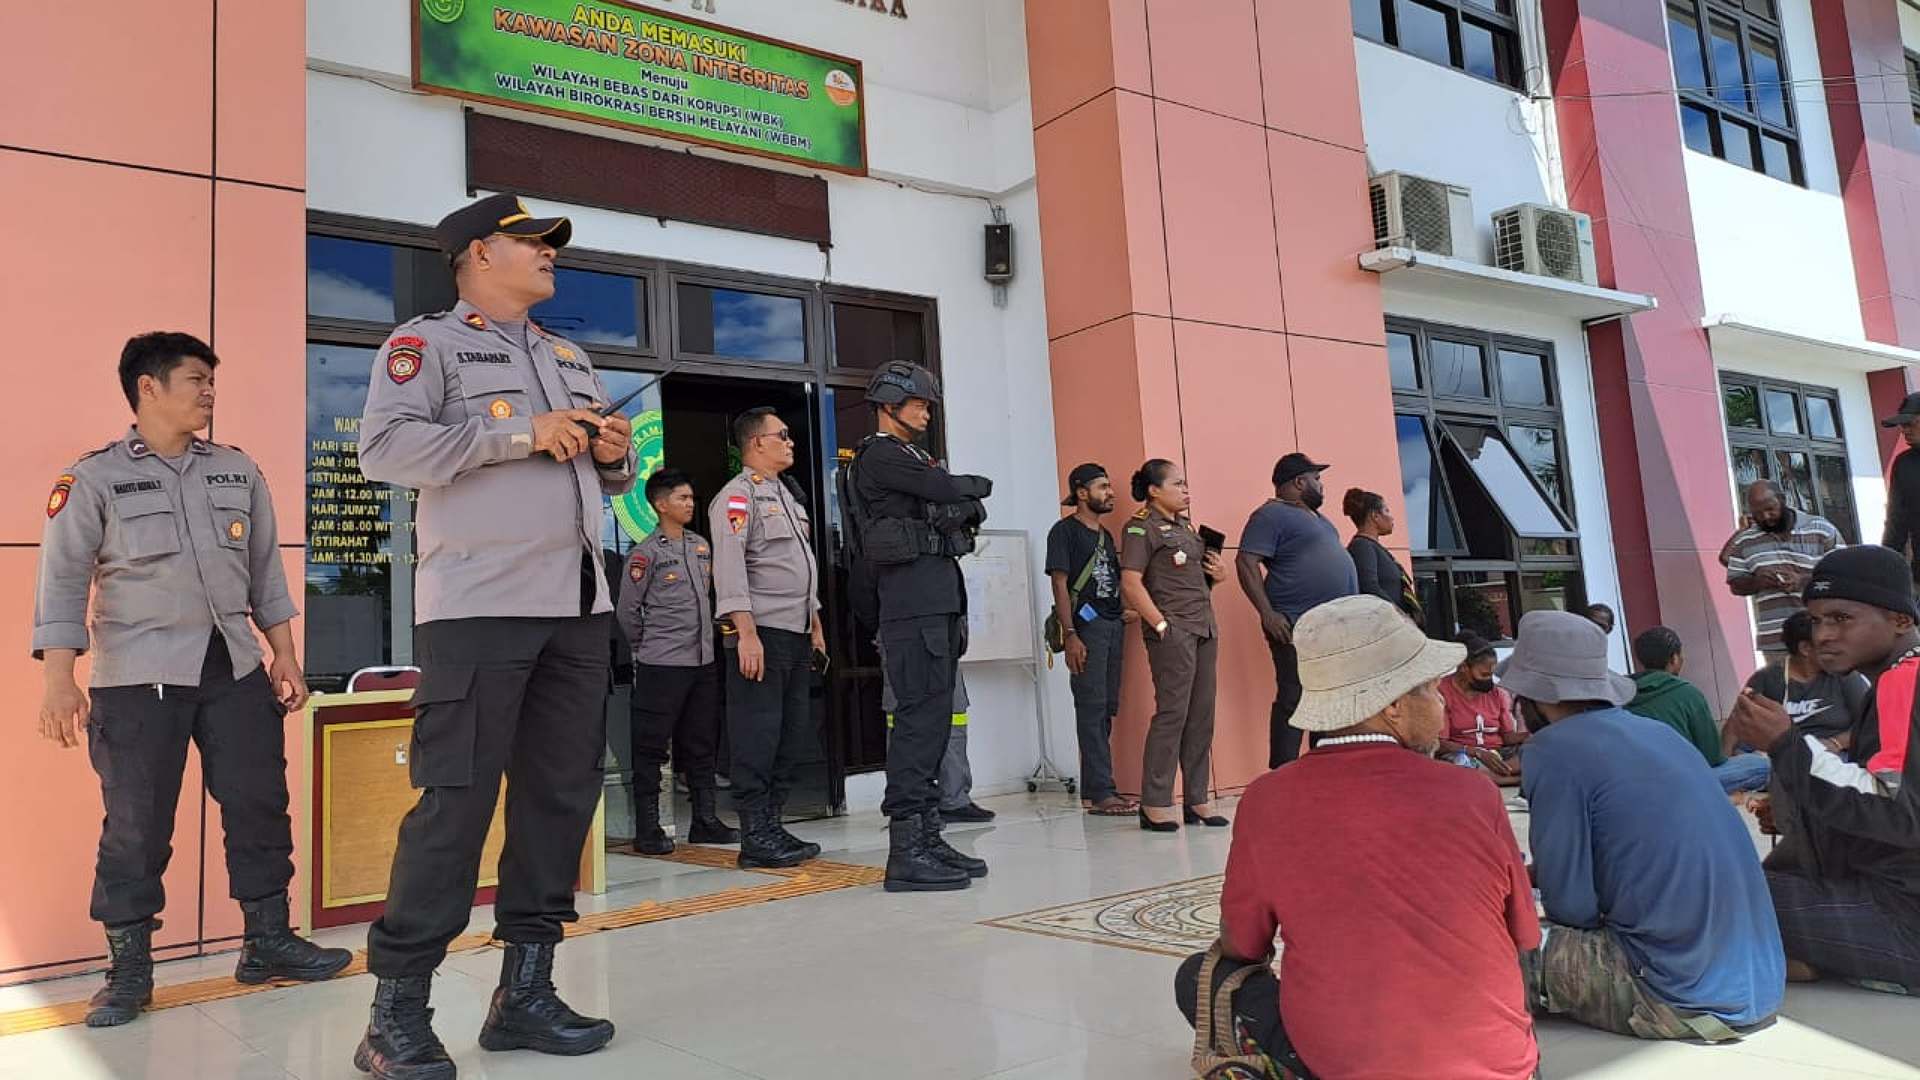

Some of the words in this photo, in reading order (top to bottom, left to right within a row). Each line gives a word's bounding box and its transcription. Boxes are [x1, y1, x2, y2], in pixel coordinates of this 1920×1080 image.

[573, 4, 635, 37] ANDA
[641, 20, 747, 63] MEMASUKI
[494, 8, 619, 56] KAWASAN
[624, 38, 688, 72] ZONA
[693, 53, 809, 100] INTEGRITAS
[641, 69, 688, 91] Menuju
[532, 63, 600, 88] WILAYAH
[604, 79, 649, 99] BEBAS
[652, 88, 684, 106] DARI
[688, 98, 742, 120] KORUPSI
[745, 109, 784, 129] (WBK)
[496, 73, 565, 98] WILAYAH
[570, 89, 645, 115] BIROKRASI
[649, 105, 696, 126] BERSIH
[700, 116, 762, 139] MELAYANI
[765, 129, 813, 151] (WBBM)
[334, 417, 360, 433] WAK
[312, 440, 338, 452] HARI
[312, 456, 335, 468] JAM
[344, 457, 360, 468] 08.
[206, 474, 248, 486] POLRI
[312, 488, 335, 499] JAM
[344, 489, 373, 501] 12.00
[375, 490, 394, 501] WIT
[312, 503, 338, 515] HARI
[341, 503, 380, 516] JUM'AT
[312, 520, 334, 531] JAM
[374, 521, 393, 532] WIT
[312, 536, 369, 548] ISTIRAHAT
[312, 551, 334, 563] JAM
